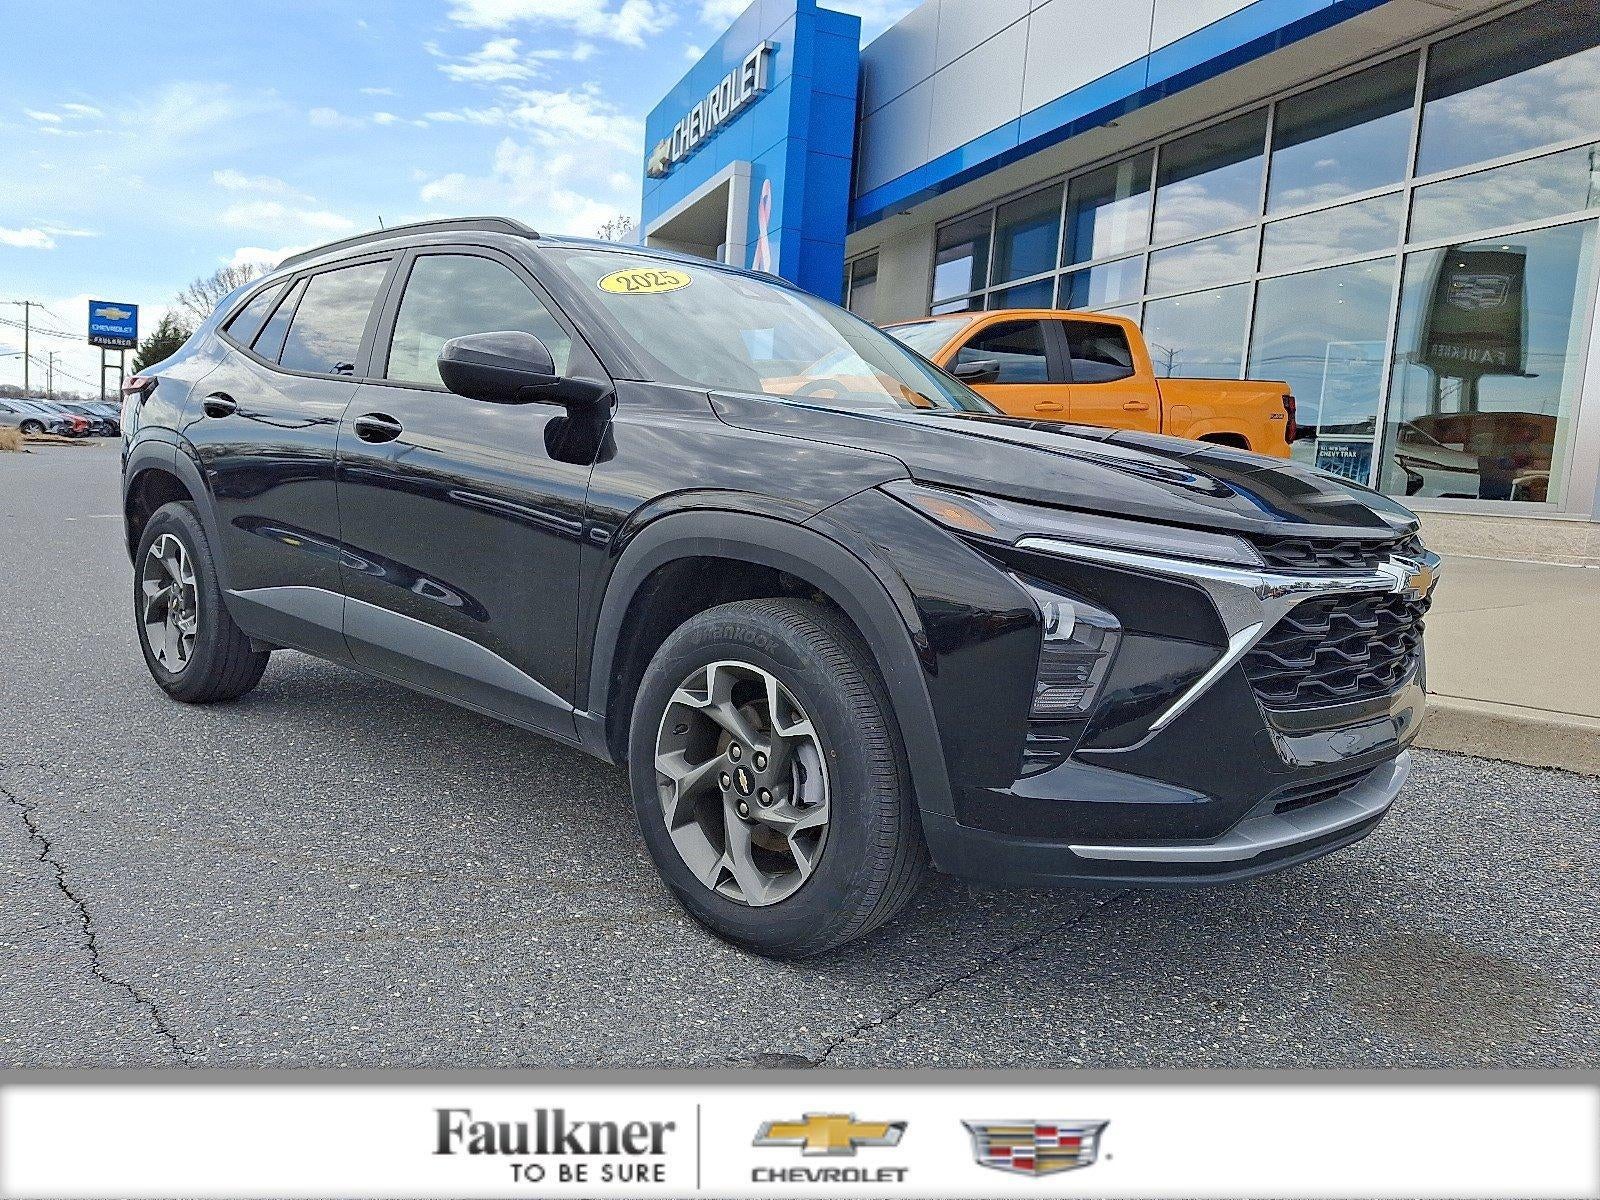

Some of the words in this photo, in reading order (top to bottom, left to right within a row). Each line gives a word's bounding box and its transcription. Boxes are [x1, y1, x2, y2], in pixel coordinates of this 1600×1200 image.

[671, 40, 772, 163] CHEVROLET
[616, 271, 680, 291] 2025
[92, 324, 133, 333] CHEVROLET
